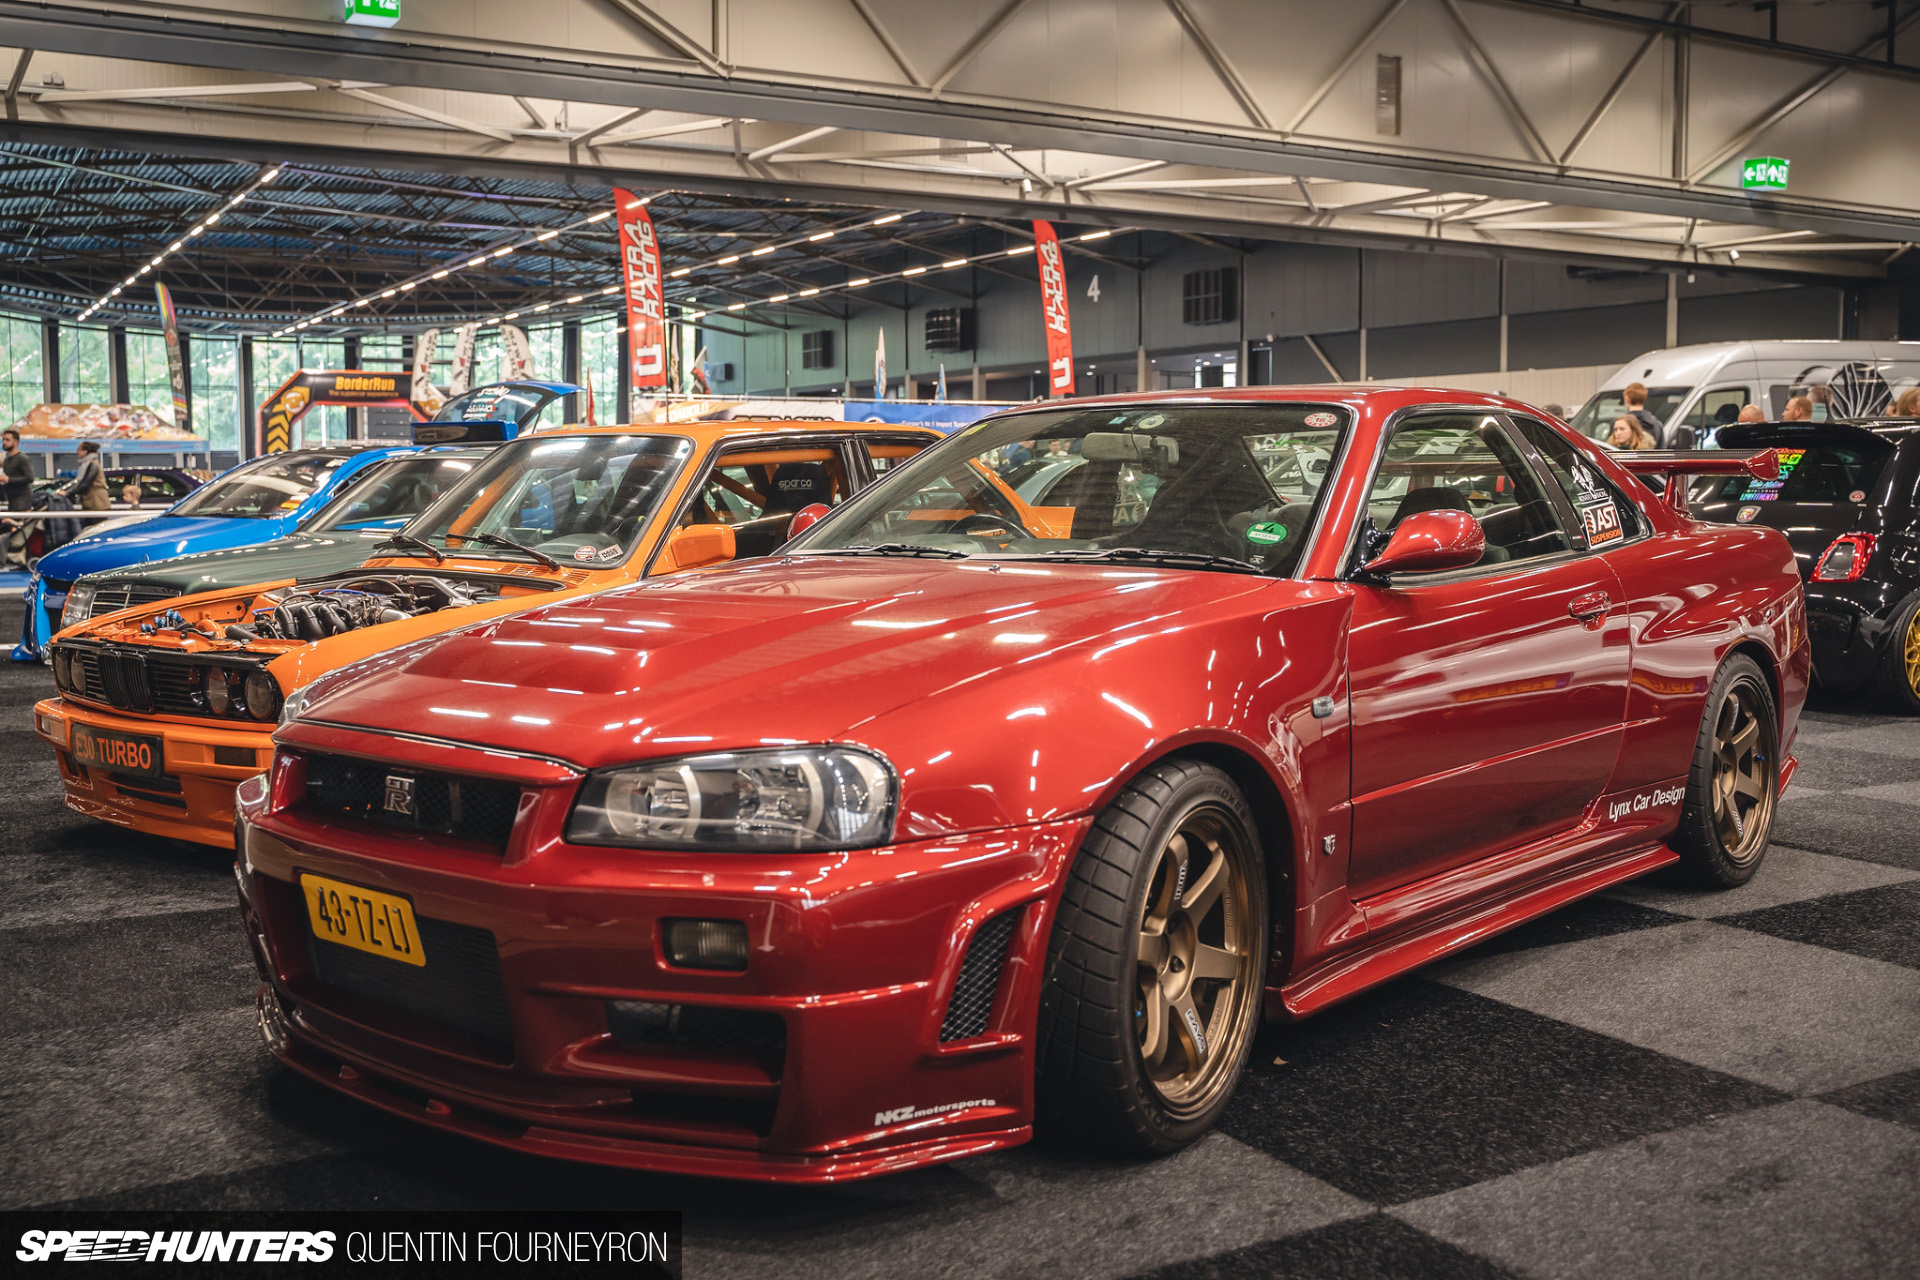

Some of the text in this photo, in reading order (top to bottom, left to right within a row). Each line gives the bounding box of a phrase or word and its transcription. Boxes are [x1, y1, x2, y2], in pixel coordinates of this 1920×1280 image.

[624, 219, 648, 315] ULTRA
[637, 221, 660, 319] RACING
[1040, 240, 1060, 330] ULTRA
[1047, 240, 1068, 334] RACING
[1087, 274, 1100, 302] 4
[335, 376, 396, 391] BorderRun
[779, 479, 812, 490] sparco
[1263, 523, 1275, 533] 4
[1596, 505, 1616, 532] AST
[1590, 529, 1622, 545] SUSPENSION
[75, 731, 151, 770] E30 TURBO
[385, 775, 415, 790] GT
[384, 787, 412, 815] R
[1609, 785, 1686, 823] Lynx Car Design
[318, 886, 411, 954] 43-TZ-LJ
[874, 1099, 996, 1126] NKZ motorsports
